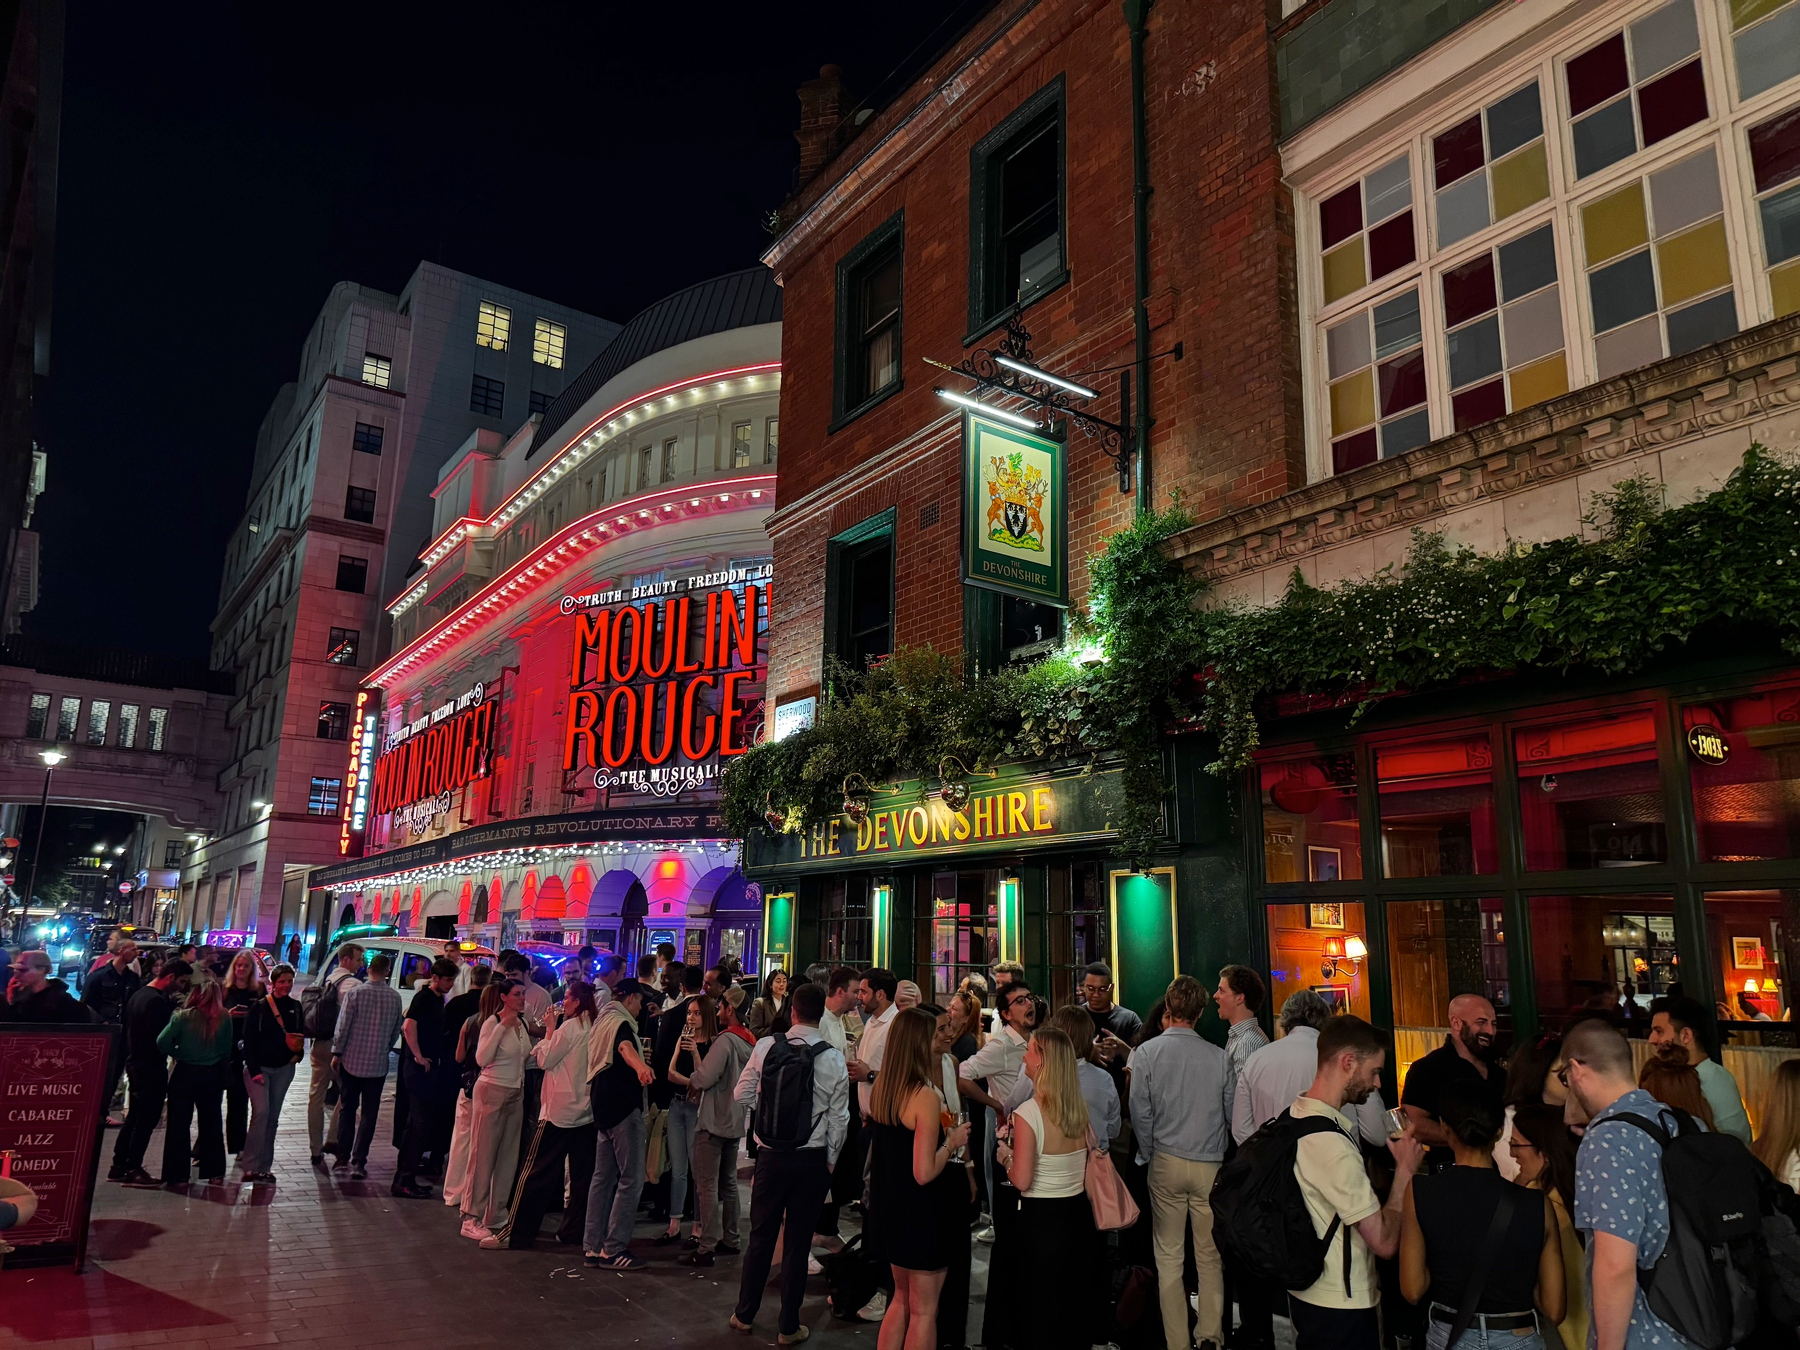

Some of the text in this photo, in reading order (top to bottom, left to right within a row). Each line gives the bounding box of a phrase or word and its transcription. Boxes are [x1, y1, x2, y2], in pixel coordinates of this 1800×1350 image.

[983, 560, 1047, 586] DEVONSHIRE
[1011, 560, 1021, 568] THE
[585, 590, 622, 607] TRUTH
[632, 580, 678, 598] BEAUTY
[689, 569, 747, 589] FREEDOM
[571, 585, 756, 687] MOULIN
[563, 671, 753, 771] ROUGE
[340, 692, 368, 854] PICCADILLY
[353, 716, 376, 830] THEATRE
[370, 735, 425, 819] MOULIN
[620, 765, 719, 785] THE MUSICAL!
[464, 825, 531, 846] LUHRMANN'S
[534, 815, 699, 836] REVOLUTIONARY
[856, 787, 1053, 851] DEVONSHIRE
[7, 1084, 82, 1096] LIVE MUSIC
[8, 1109, 73, 1122] CABARET
[14, 1134, 54, 1146] JAZZ
[12, 1158, 60, 1172] OMEDY
